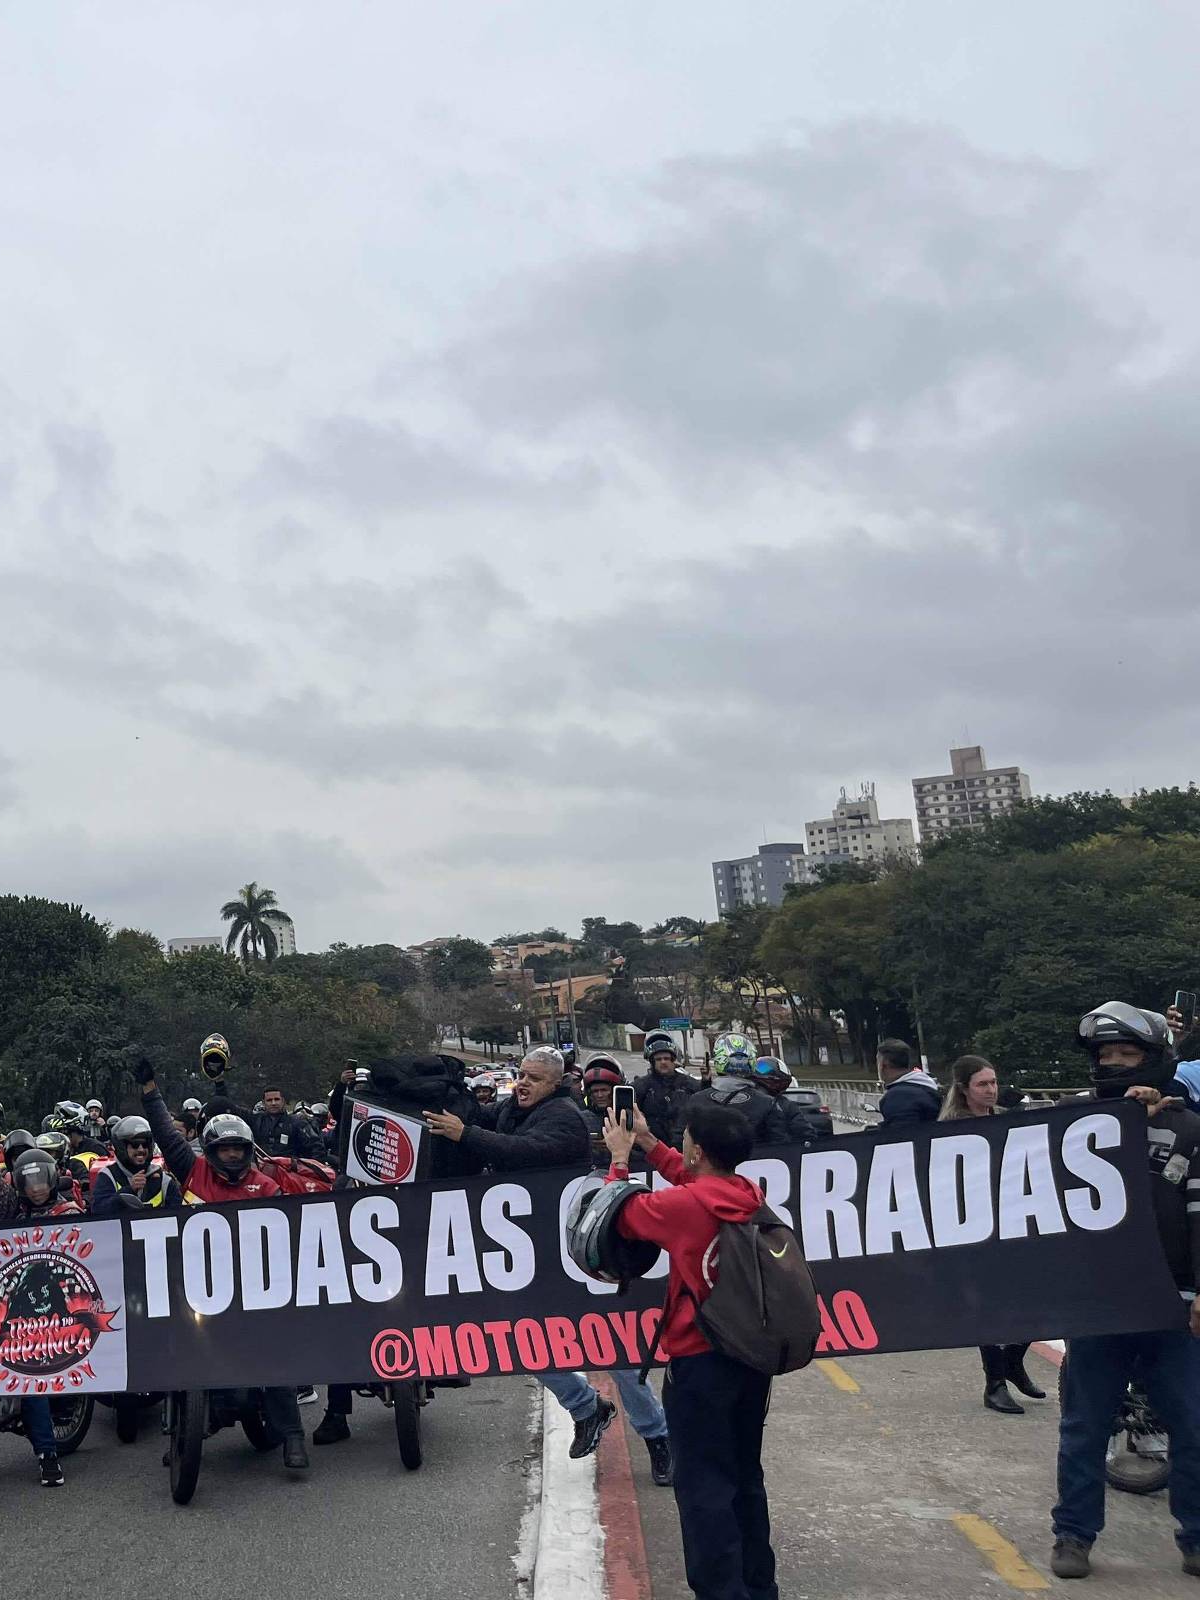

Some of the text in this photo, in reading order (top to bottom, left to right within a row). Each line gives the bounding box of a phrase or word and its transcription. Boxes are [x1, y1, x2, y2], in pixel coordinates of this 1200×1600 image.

[371, 1124, 387, 1136] FORA
[369, 1139, 399, 1155] CAMPINAS
[390, 1138, 399, 1148] DE
[367, 1155, 397, 1171] CAMPINAS
[367, 1162, 377, 1171] VAI
[130, 1113, 1128, 1319] TODAS AS QBRADAS
[7, 1312, 61, 1340] TROPA
[61, 1316, 74, 1327] DO
